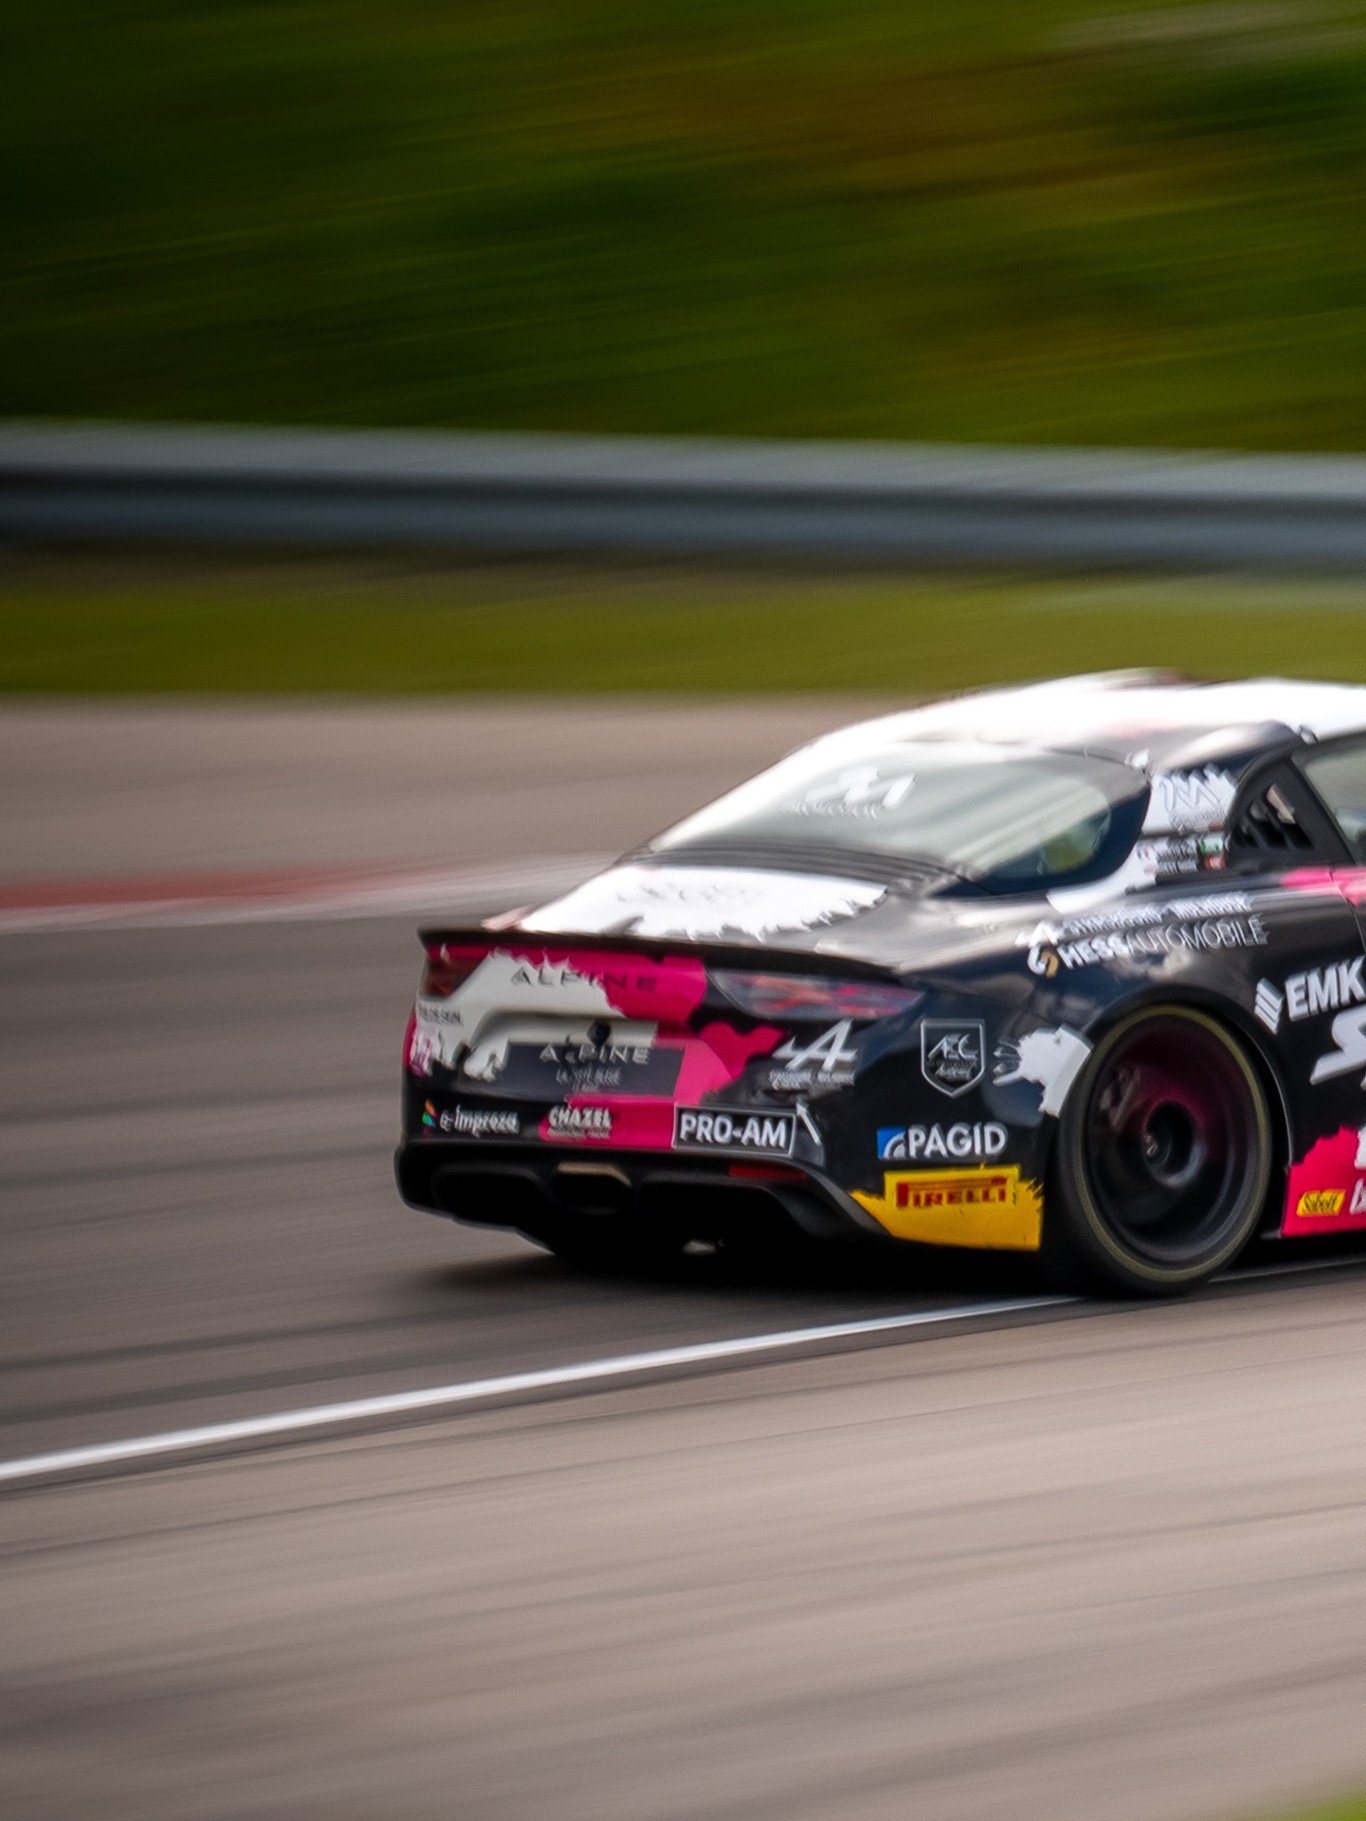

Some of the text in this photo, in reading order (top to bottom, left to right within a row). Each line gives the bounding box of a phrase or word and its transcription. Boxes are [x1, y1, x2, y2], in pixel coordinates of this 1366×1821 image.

[511, 966, 657, 992] ALPINE
[680, 1112, 787, 1149] PRO-AM
[908, 1122, 1008, 1156] PAGID
[896, 1176, 1008, 1208] PIRELLI
